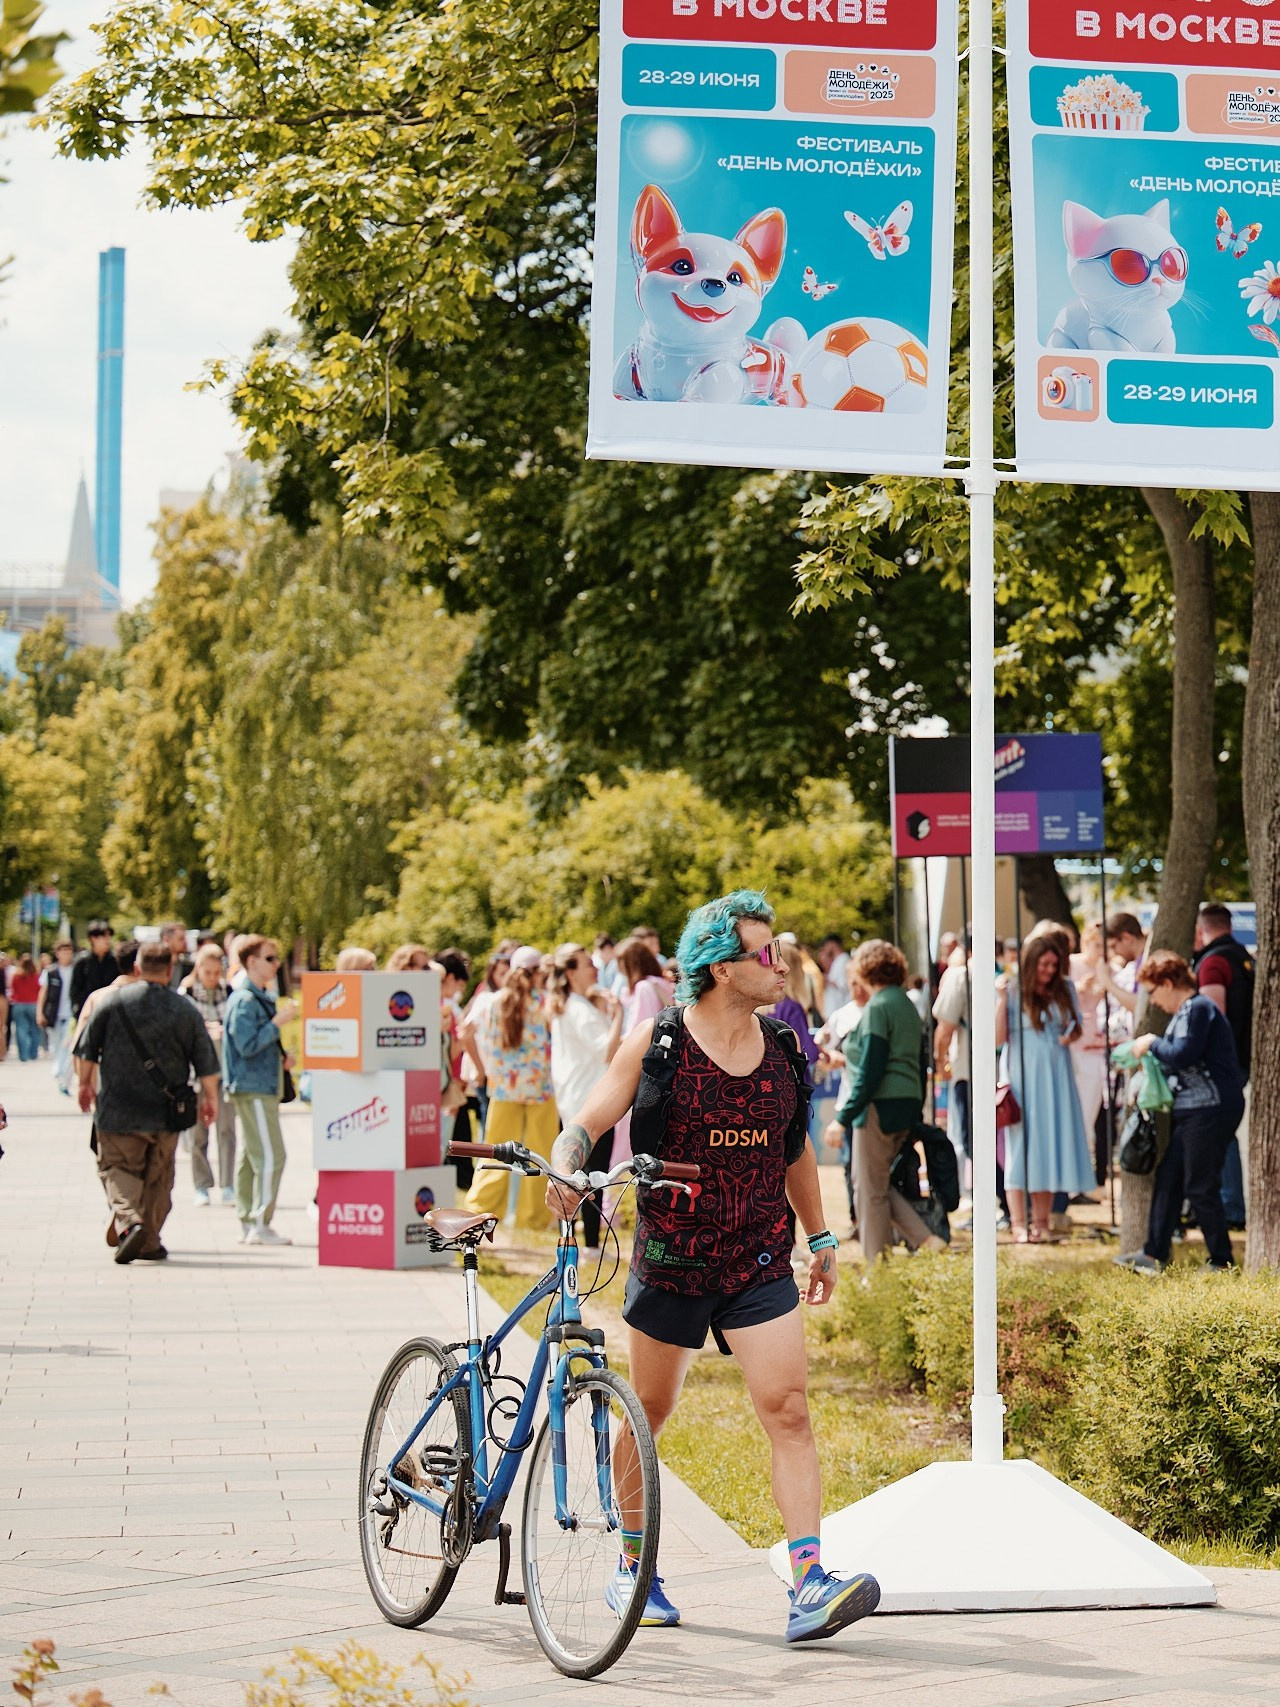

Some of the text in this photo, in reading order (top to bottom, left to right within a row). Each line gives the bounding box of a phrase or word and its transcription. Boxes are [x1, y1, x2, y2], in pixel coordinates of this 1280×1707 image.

[713, 0, 888, 25] МОСКВЕ
[1075, 10, 1101, 38] В
[639, 69, 760, 88] 28-29 ИЮНЯ
[828, 70, 856, 80] ДЕНЬ
[828, 79, 889, 90] МОЛОДЁЖИ
[870, 90, 894, 99] 2025
[1228, 93, 1255, 102] ДЕНЬ
[796, 136, 923, 155] ФЕСТИВАЛЬ
[717, 155, 922, 178] «ДЕНЬ МОЛОДЁЖИ»
[1129, 176, 1192, 192] «ДЕНЬ
[1123, 384, 1257, 404] 28-29 ИЮНЯ
[709, 1129, 768, 1147] DDSM
[328, 1203, 385, 1223] ЛЕТО
[338, 1224, 384, 1236] МОСКВЕ
